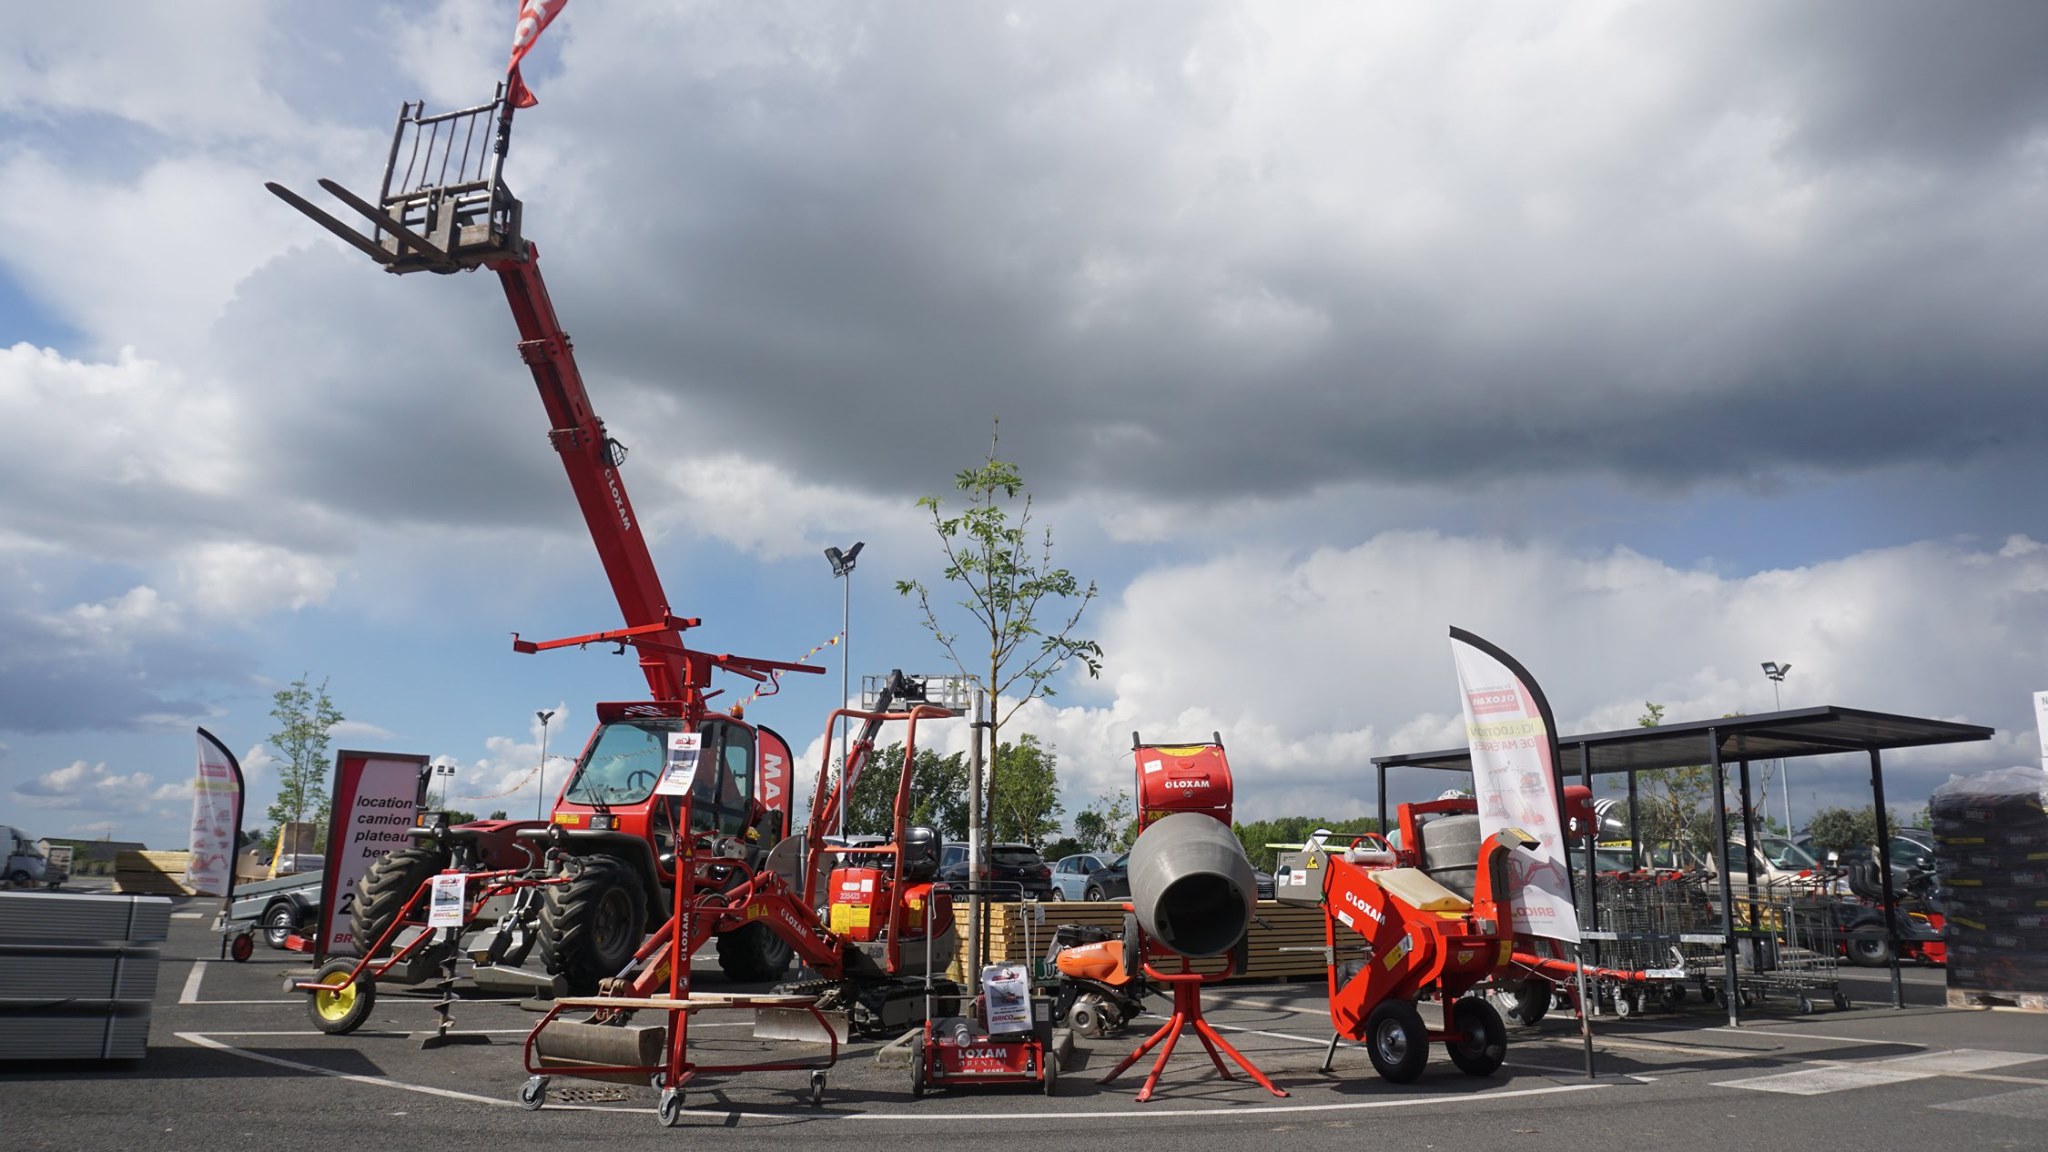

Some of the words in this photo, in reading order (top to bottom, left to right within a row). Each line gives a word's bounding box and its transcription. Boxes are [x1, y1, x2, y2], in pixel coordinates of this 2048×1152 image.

[608, 480, 631, 531] LOXAM
[1173, 780, 1210, 788] LOXAM
[356, 795, 413, 809] location
[357, 814, 411, 826] camion
[354, 830, 409, 843] plateau
[1352, 895, 1386, 925] LOXAM
[681, 912, 689, 952] LOXAM
[784, 912, 807, 938] LOXAM
[958, 1048, 1007, 1059] LOXAM
